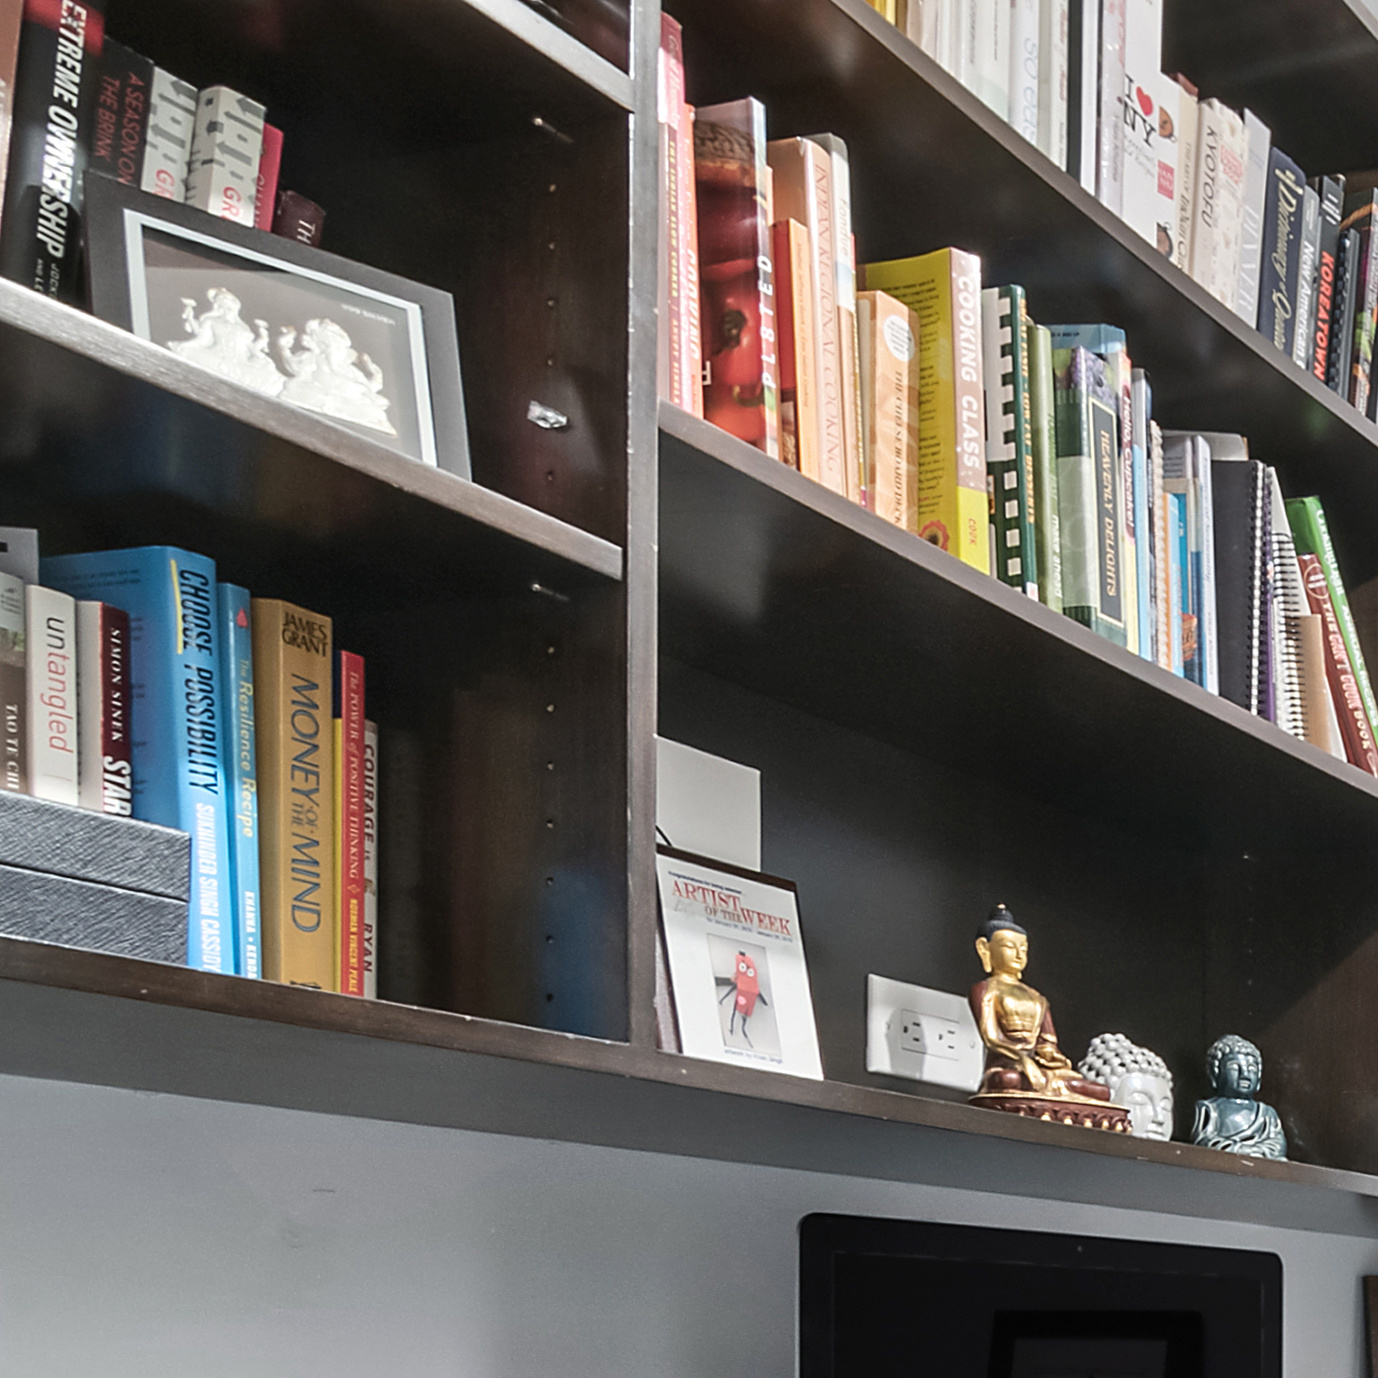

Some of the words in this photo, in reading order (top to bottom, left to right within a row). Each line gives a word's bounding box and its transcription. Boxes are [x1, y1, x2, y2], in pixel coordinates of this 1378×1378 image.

[53, 0, 87, 108] EXTREME
[129, 72, 144, 86] A
[100, 75, 120, 109] THE
[1125, 73, 1134, 102] I
[94, 111, 116, 162] BRINK
[121, 88, 145, 152] SEASON
[1124, 100, 1156, 148] NY
[37, 104, 78, 259] OWNERSHIP
[117, 154, 137, 185] ON
[153, 169, 175, 199] GR
[1201, 125, 1218, 228] KYOTOFU
[219, 186, 242, 218] GR
[815, 164, 830, 241] INDIAN
[297, 219, 316, 244] TH
[670, 215, 678, 247] SLOW
[1303, 240, 1316, 275] New
[757, 254, 776, 389] PL8TED
[819, 247, 835, 357] REGIONAL
[958, 276, 977, 382] COOKING
[1298, 278, 1313, 352] American
[1313, 251, 1334, 381] KOREATOWN
[895, 371, 904, 392] THE
[823, 366, 839, 472] COOKING
[961, 394, 981, 470] CLASS
[1123, 396, 1132, 443] Hello,
[895, 446, 904, 490] BOARD
[1100, 429, 1114, 513] HEAVENLY
[1124, 447, 1135, 527] Cupcake!
[1051, 514, 1060, 553] make
[1104, 516, 1116, 597] DELIGHTS
[1054, 554, 1063, 598] ahead
[180, 569, 213, 656] CHOOSE
[283, 611, 327, 641] JAMES
[110, 627, 122, 685] SIMON
[282, 626, 329, 658] GRANT
[40, 616, 74, 753] untangled
[1322, 601, 1337, 631] THE
[1352, 710, 1372, 750] BOOK
[5, 703, 18, 733] TAO
[110, 690, 124, 742] SINEK
[184, 664, 219, 795] POSSIBILITY
[239, 681, 254, 771] Resilience
[290, 672, 321, 808] MONEY
[349, 691, 360, 740] POWER
[5, 737, 18, 757] TE
[6, 758, 20, 790] CHI
[103, 755, 132, 817] STAR
[237, 778, 257, 838] Recipe
[349, 757, 361, 814] POSITIVE
[363, 744, 375, 844] COURAGE
[196, 803, 217, 875] SUKHINDER
[291, 802, 305, 827] THE
[349, 815, 360, 879] THINKING
[199, 877, 219, 917] SINGH
[290, 831, 321, 934] MIND
[672, 879, 741, 913] ARTIST
[244, 891, 256, 933] KHANNA
[704, 905, 718, 918] OF
[722, 908, 743, 923] THE
[741, 907, 791, 936] WEEK
[200, 919, 222, 973] CASSIDY
[363, 922, 374, 973] RYAN
